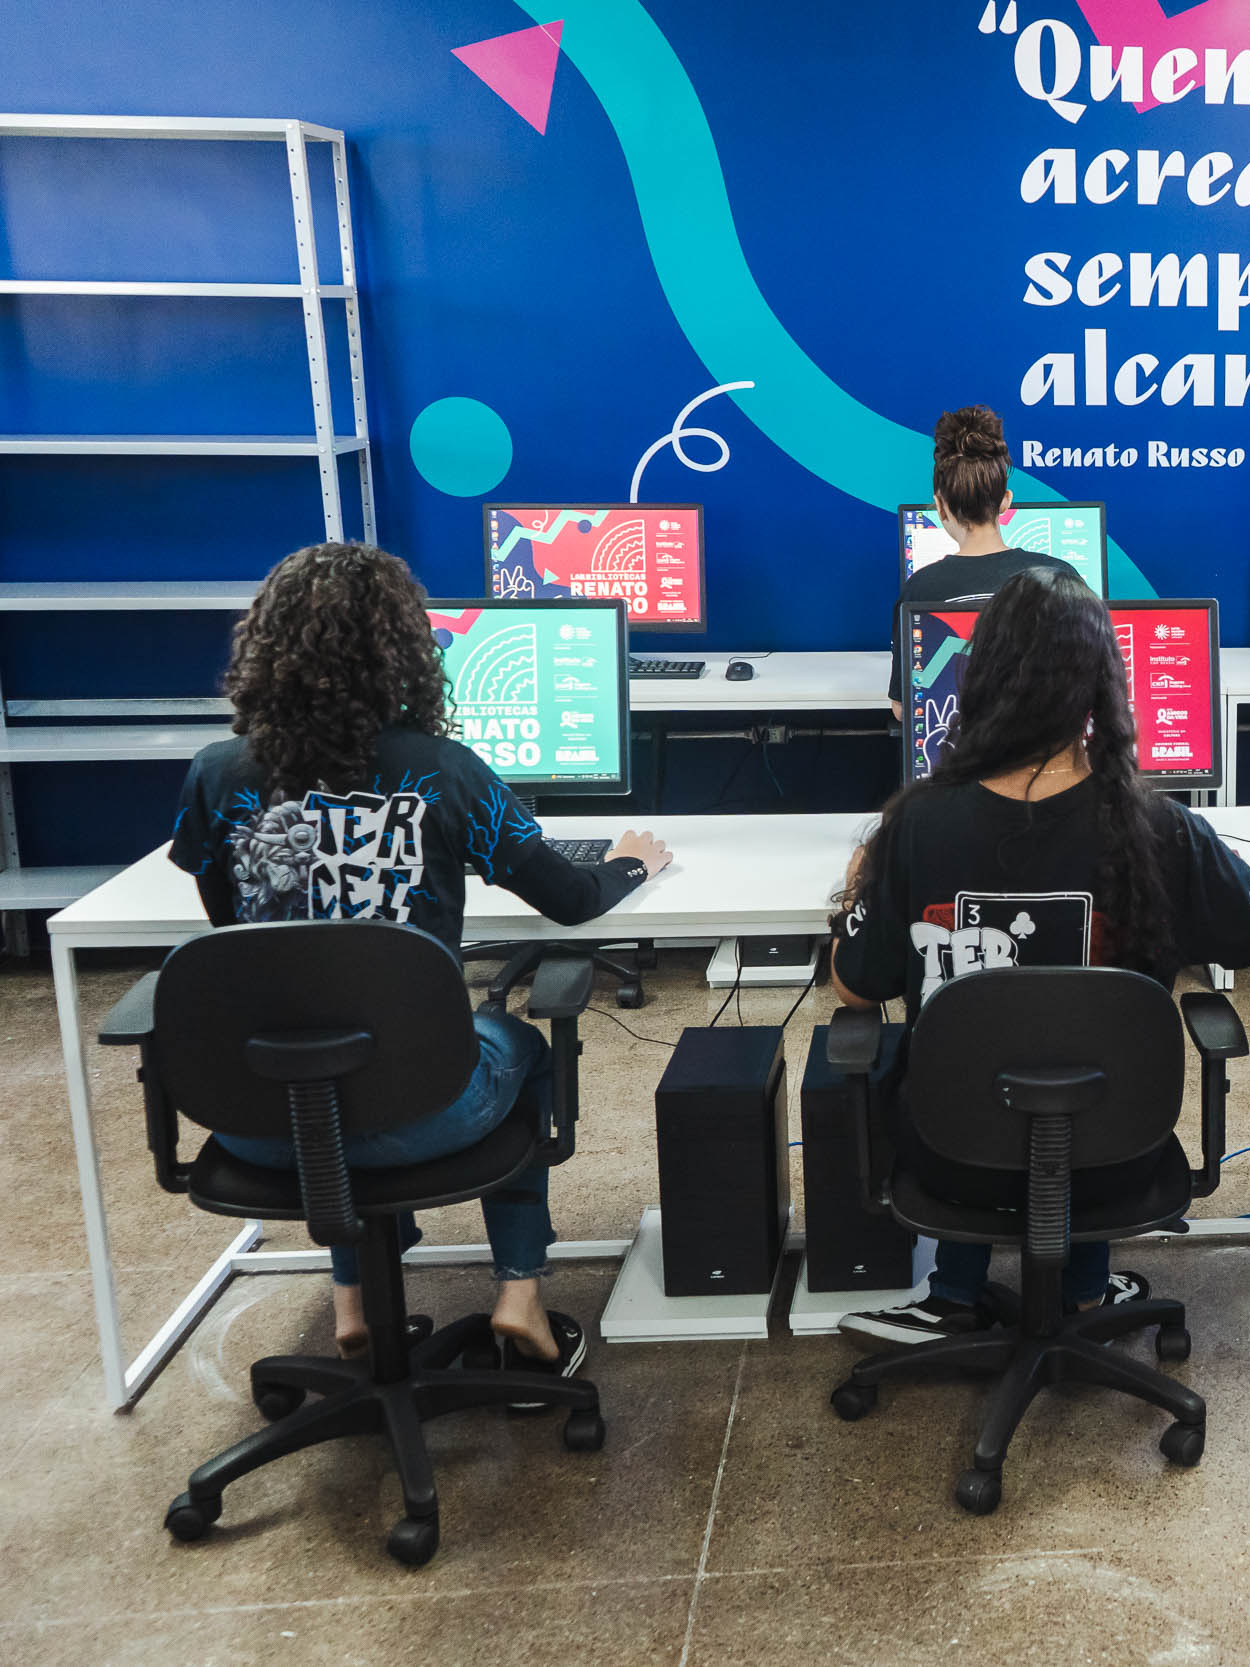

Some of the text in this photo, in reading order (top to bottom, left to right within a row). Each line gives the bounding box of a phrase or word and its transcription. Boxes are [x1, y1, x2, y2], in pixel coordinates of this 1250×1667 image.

[1022, 440, 1246, 468] Renato Russo
[570, 581, 648, 596] RENATO
[301, 790, 427, 862] TER
[967, 903, 981, 925] 3
[909, 921, 1018, 977] TER
